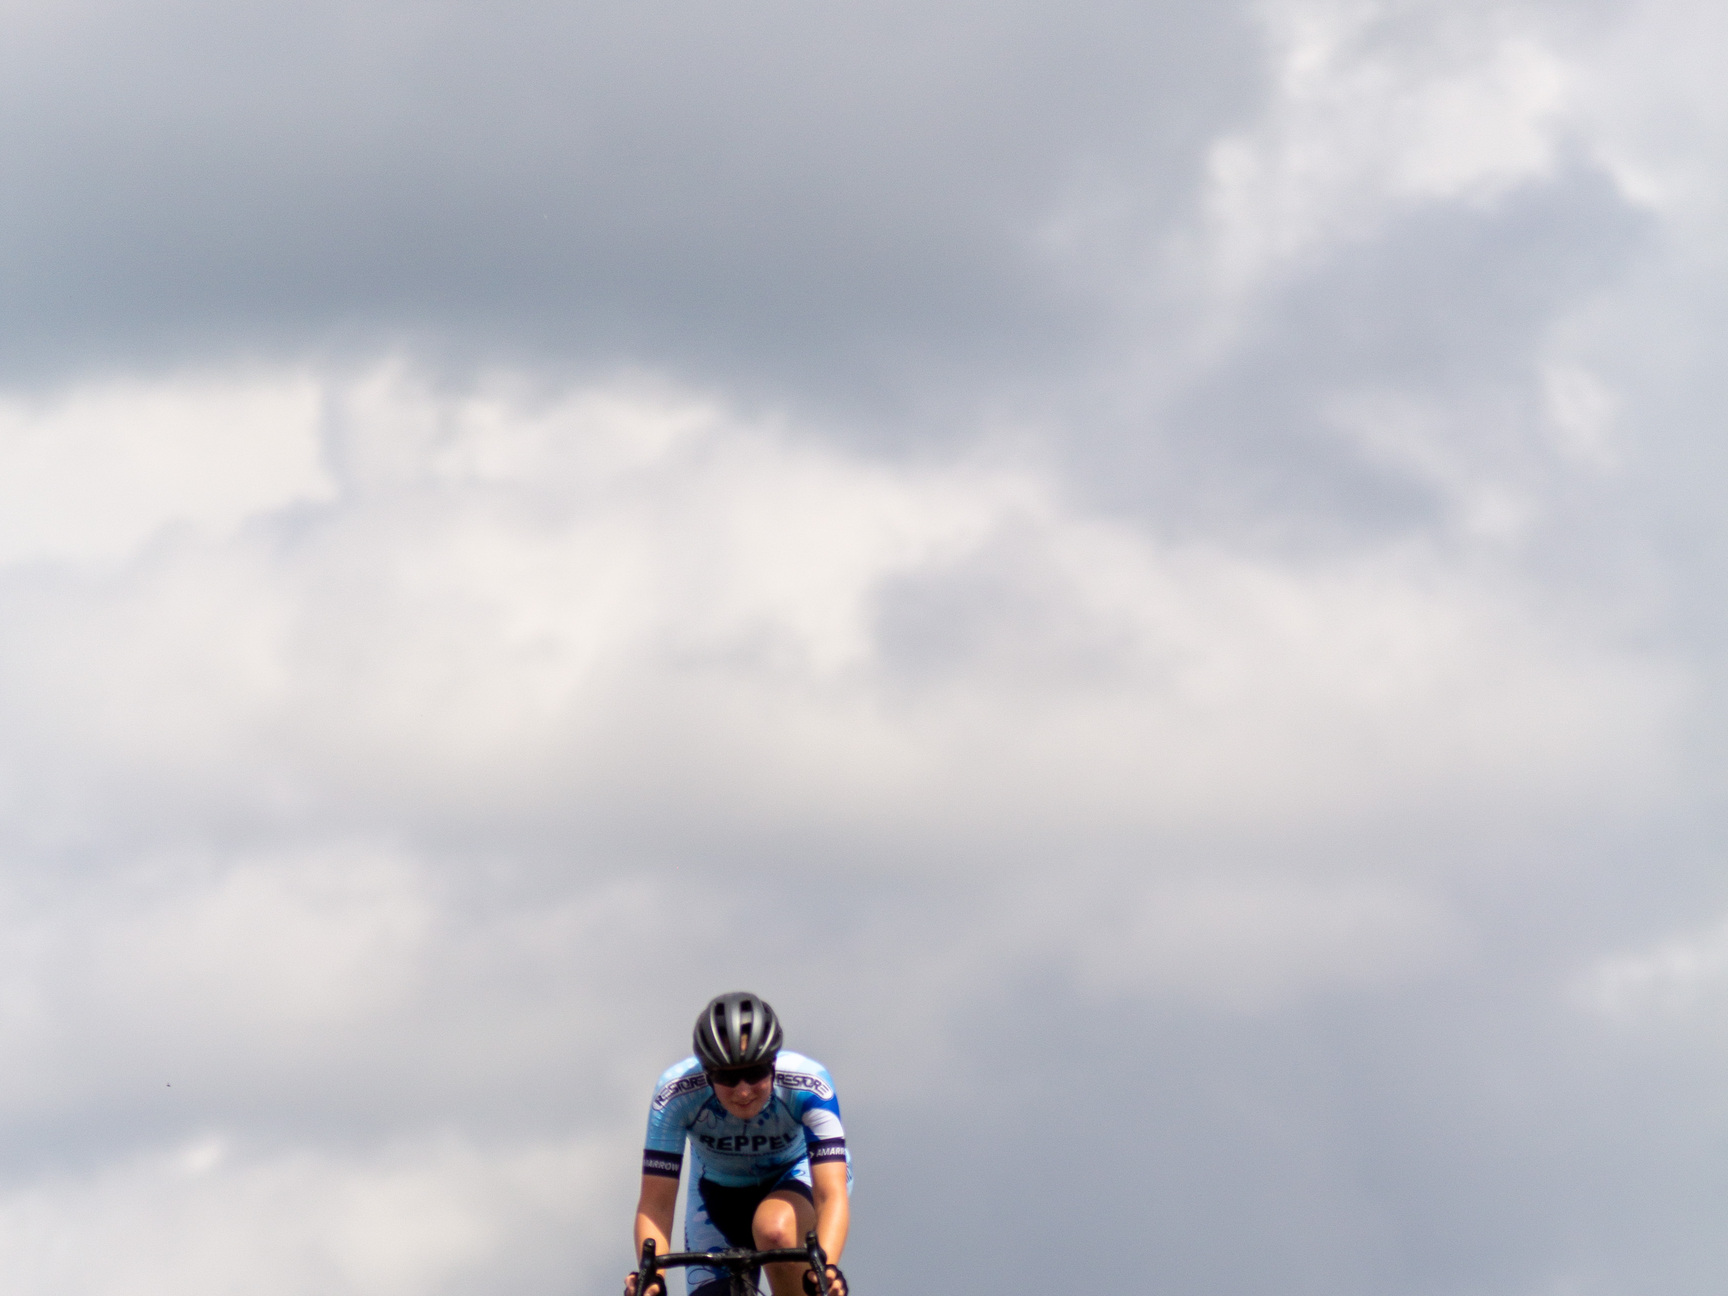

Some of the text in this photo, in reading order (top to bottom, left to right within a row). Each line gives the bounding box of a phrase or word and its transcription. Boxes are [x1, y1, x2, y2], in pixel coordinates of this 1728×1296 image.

[654, 1075, 707, 1105] RESTORE
[775, 1073, 829, 1096] RESTORE
[700, 1133, 798, 1152] REPPEL
